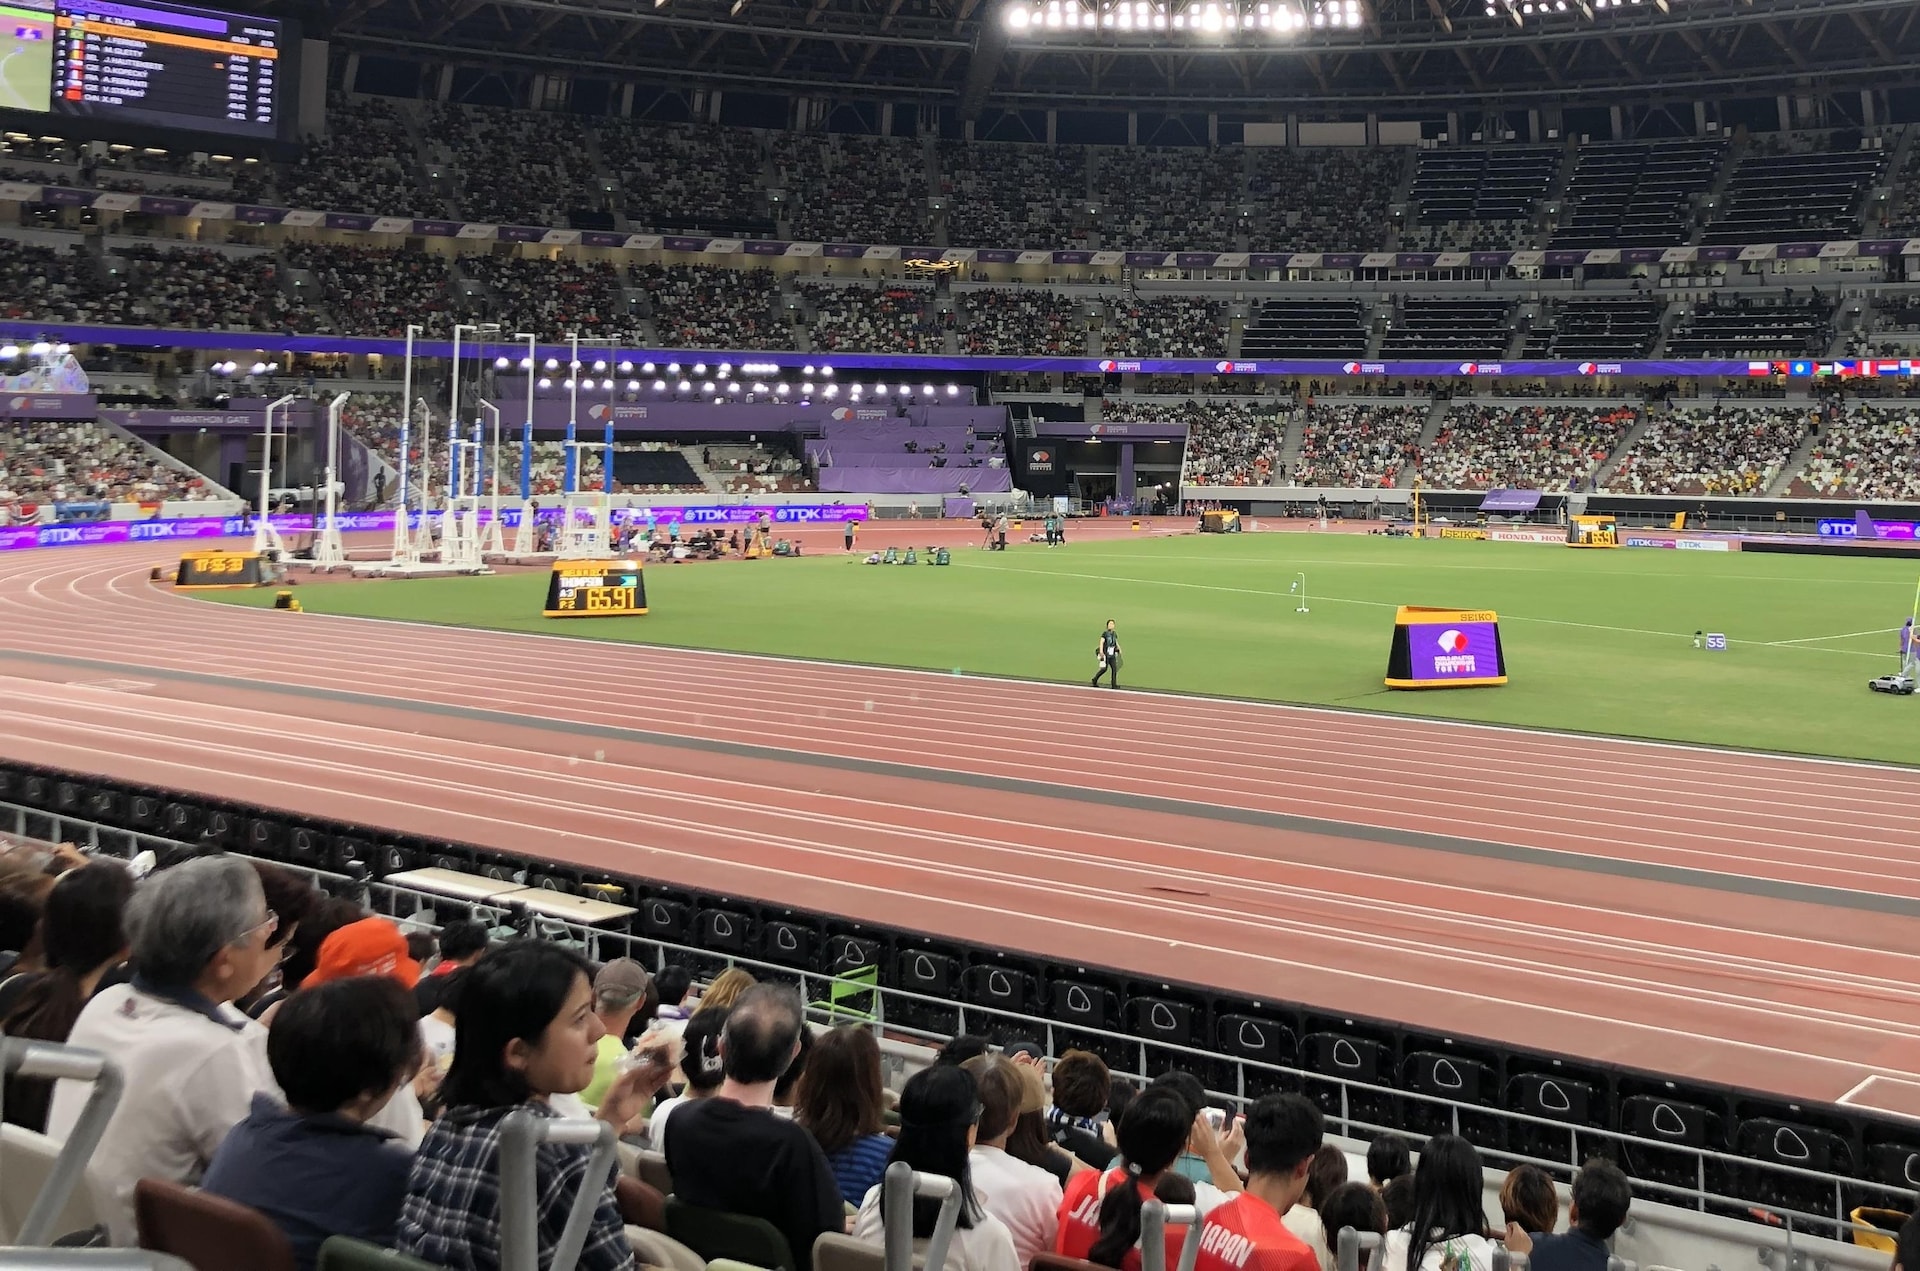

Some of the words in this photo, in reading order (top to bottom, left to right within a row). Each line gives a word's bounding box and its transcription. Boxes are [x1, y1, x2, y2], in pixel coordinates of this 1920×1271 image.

[170, 415, 224, 424] MARATHON
[226, 416, 251, 424] GATE
[694, 509, 728, 520] TDK
[787, 508, 821, 519] TDK
[50, 527, 83, 542] TDK
[141, 523, 177, 538] TDK
[1498, 533, 1535, 541] HONDA
[1633, 538, 1651, 546] TDK
[560, 576, 604, 587] THOMPSON
[1707, 637, 1725, 648] 55
